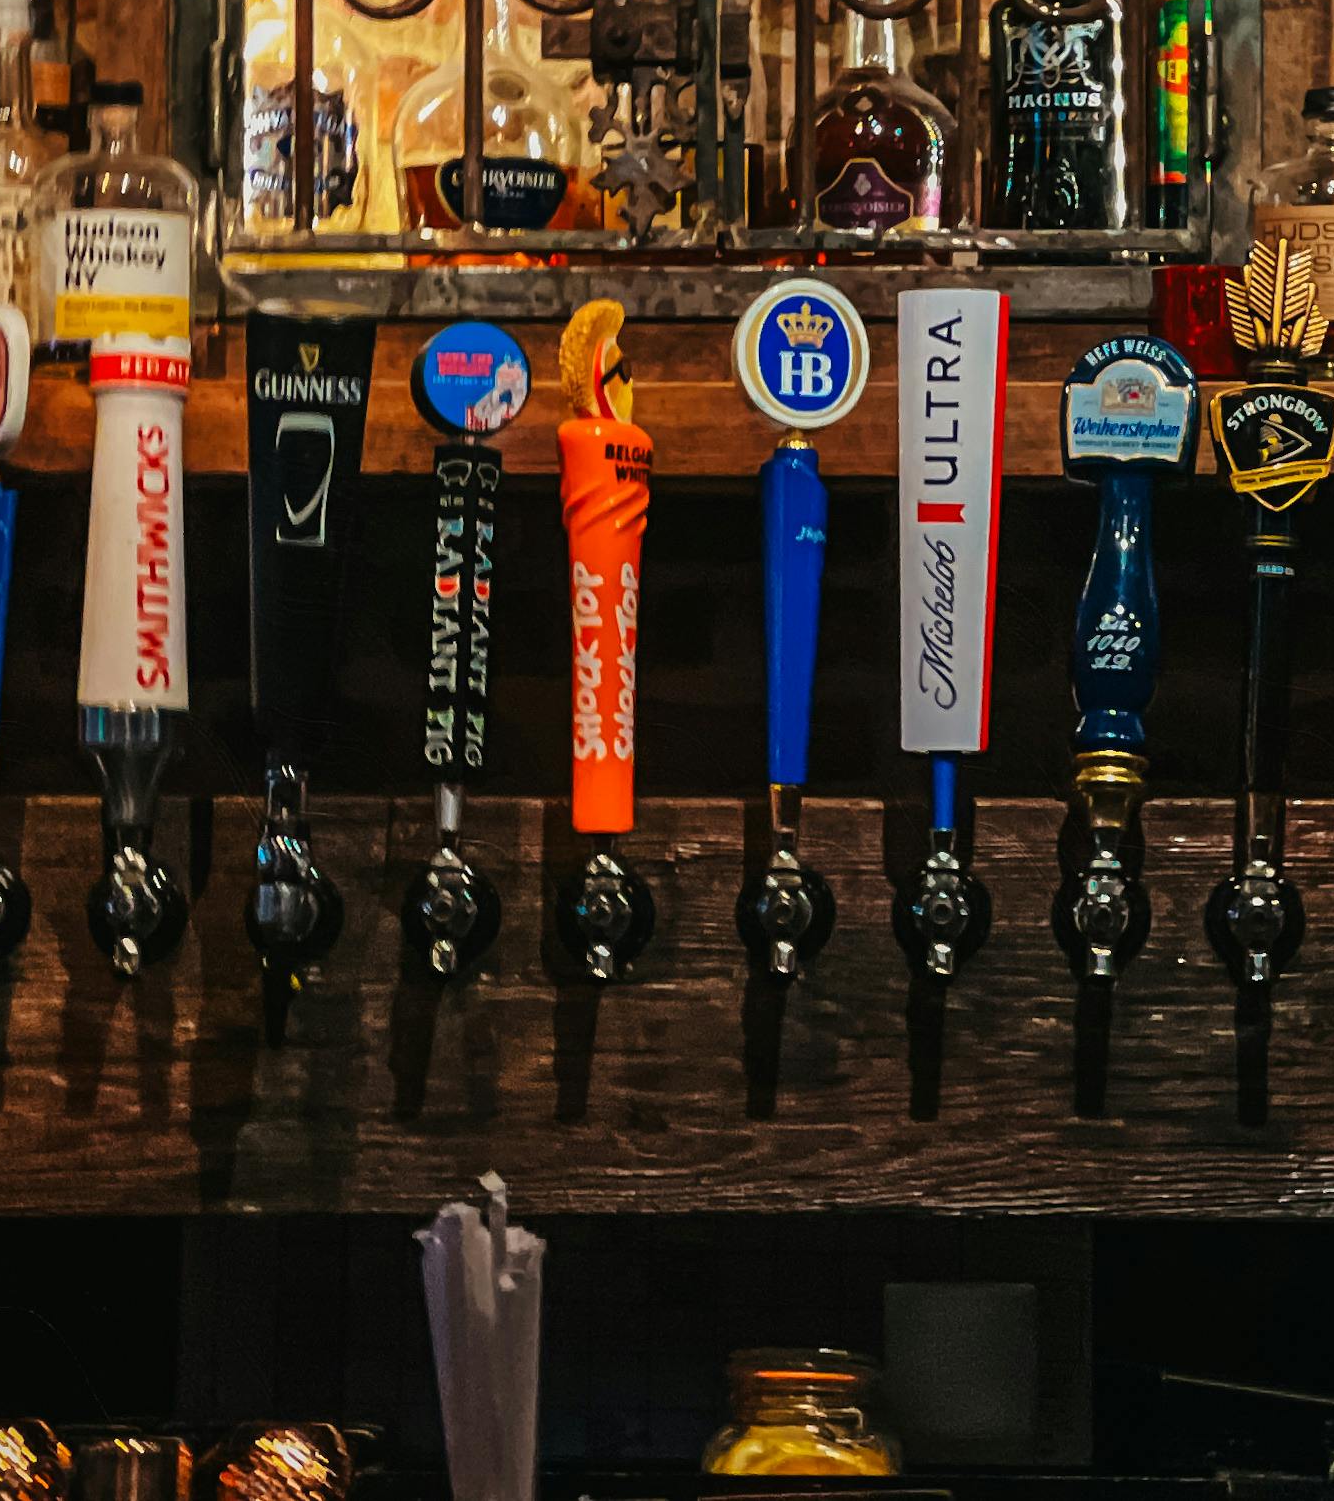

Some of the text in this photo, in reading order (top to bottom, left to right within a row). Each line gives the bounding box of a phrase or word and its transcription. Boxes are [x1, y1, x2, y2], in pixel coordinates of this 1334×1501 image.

[1008, 92, 1102, 109] MAGNUS
[64, 215, 160, 241] Hudson
[64, 242, 166, 273] Whiskey
[1085, 339, 1166, 367] HEFE WEISS
[255, 370, 363, 406] GUINNESS
[778, 350, 834, 397] HB
[1073, 416, 1181, 441] Weihenstephan
[1226, 393, 1329, 435] STRONGBOW
[918, 315, 964, 710] Michelob ULTRA
[425, 515, 465, 766] RADIANT PIG
[465, 517, 494, 768] RADIANT PIG
[1087, 634, 1141, 652] 1040
[573, 561, 607, 762] SHOCK TOP
[614, 562, 641, 762] SHOCK TOP
